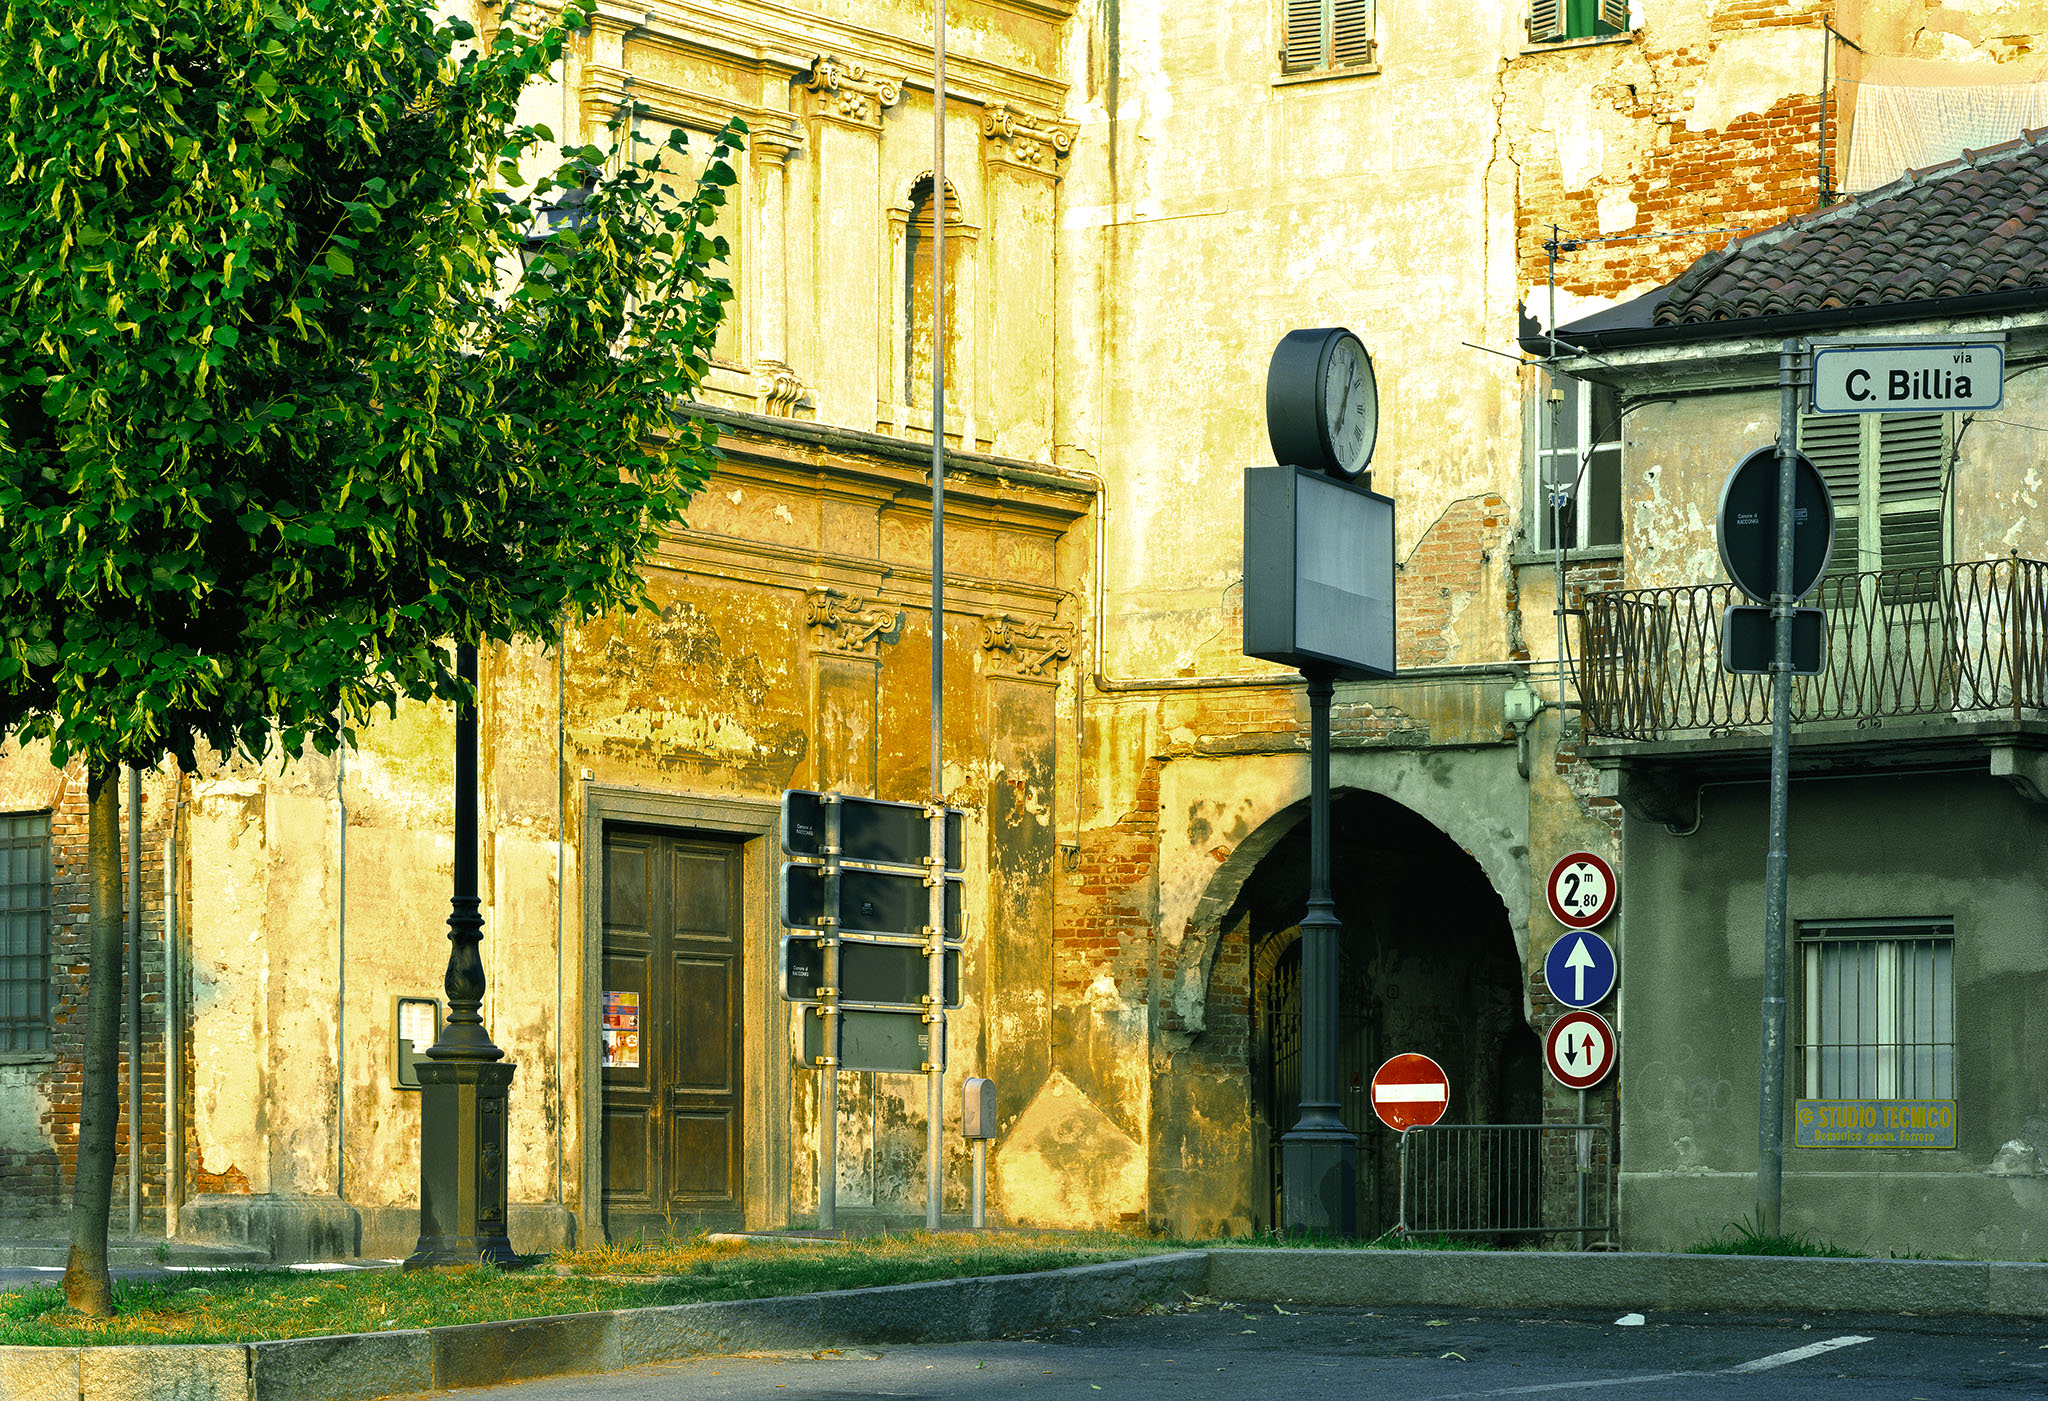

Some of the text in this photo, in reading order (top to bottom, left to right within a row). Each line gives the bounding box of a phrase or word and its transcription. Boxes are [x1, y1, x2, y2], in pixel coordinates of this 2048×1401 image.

[1953, 351, 1972, 364] via
[1846, 369, 1972, 401] C. Billia
[1818, 1106, 1876, 1128] STUDIO
[1882, 1106, 1951, 1128] TECNICO
[1814, 1129, 1935, 1144] Domenico geom. Ferrero
